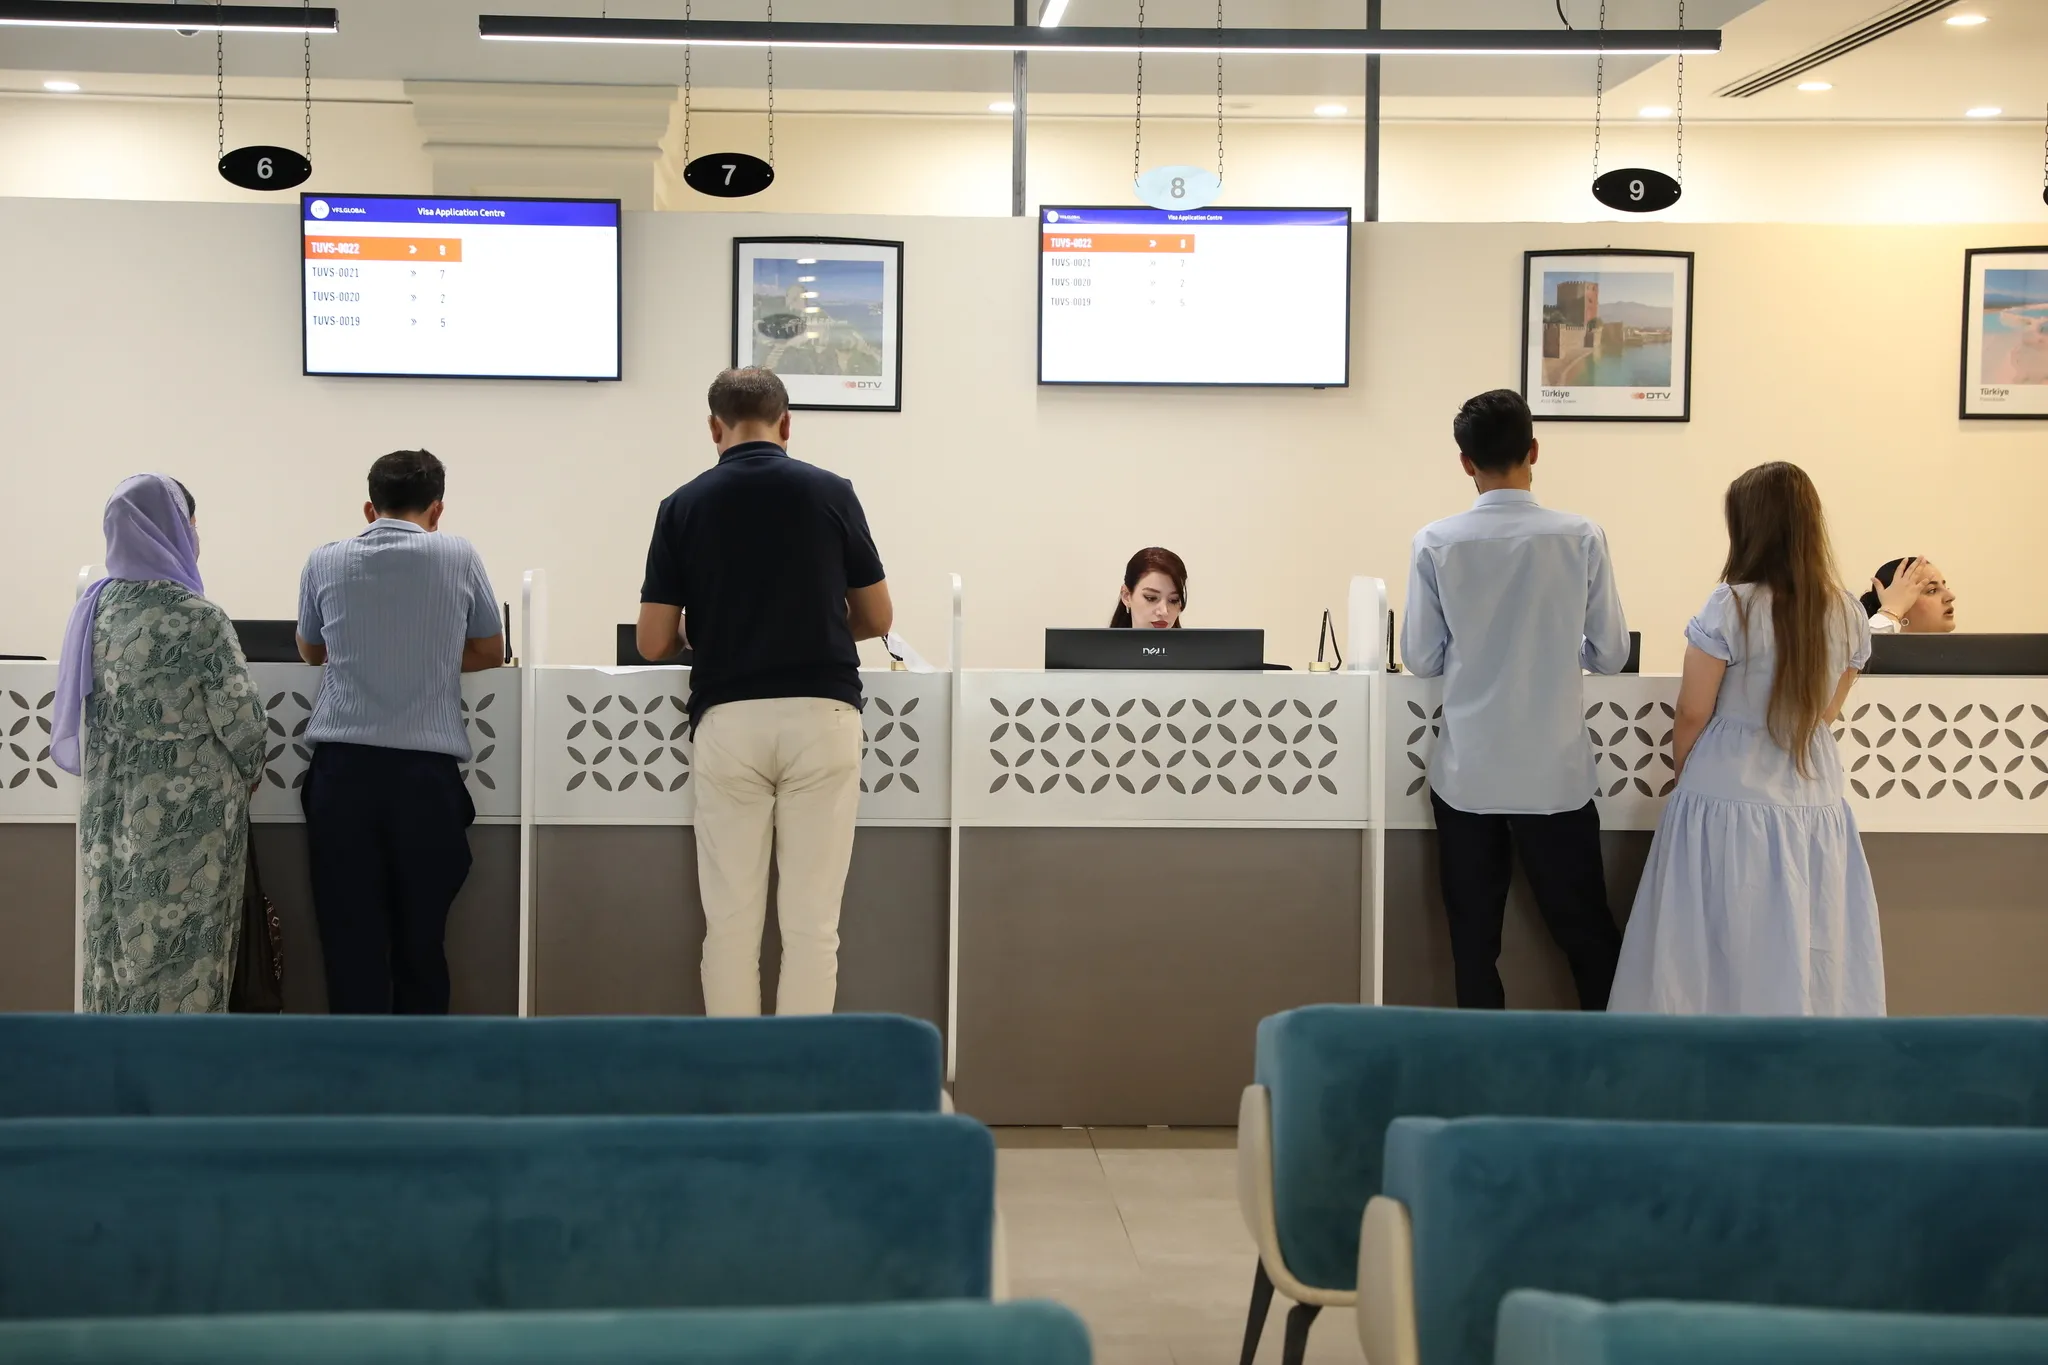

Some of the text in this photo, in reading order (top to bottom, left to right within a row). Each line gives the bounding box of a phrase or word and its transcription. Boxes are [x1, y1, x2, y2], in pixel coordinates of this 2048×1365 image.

[257, 157, 273, 179] 6
[721, 164, 736, 186] 7
[1170, 177, 1186, 199] 8
[1629, 179, 1645, 201] 9
[417, 207, 506, 218] Visa Application Centre
[1178, 214, 1207, 222] Application
[311, 241, 360, 254] TUVS-0022
[1050, 237, 1093, 249] TUVS-0022
[1051, 258, 1091, 267] TUVS-0021
[312, 266, 445, 279] TUVS-0021 7
[1051, 277, 1091, 287] TUVS-0020
[312, 291, 445, 304] TUVS-0020 2
[1051, 297, 1091, 306] TUVS-0019
[313, 315, 446, 328] TUVS-0019 5
[857, 381, 882, 389] DTV
[1541, 389, 1570, 399] Türkiye
[1980, 387, 2010, 397] Türkiye
